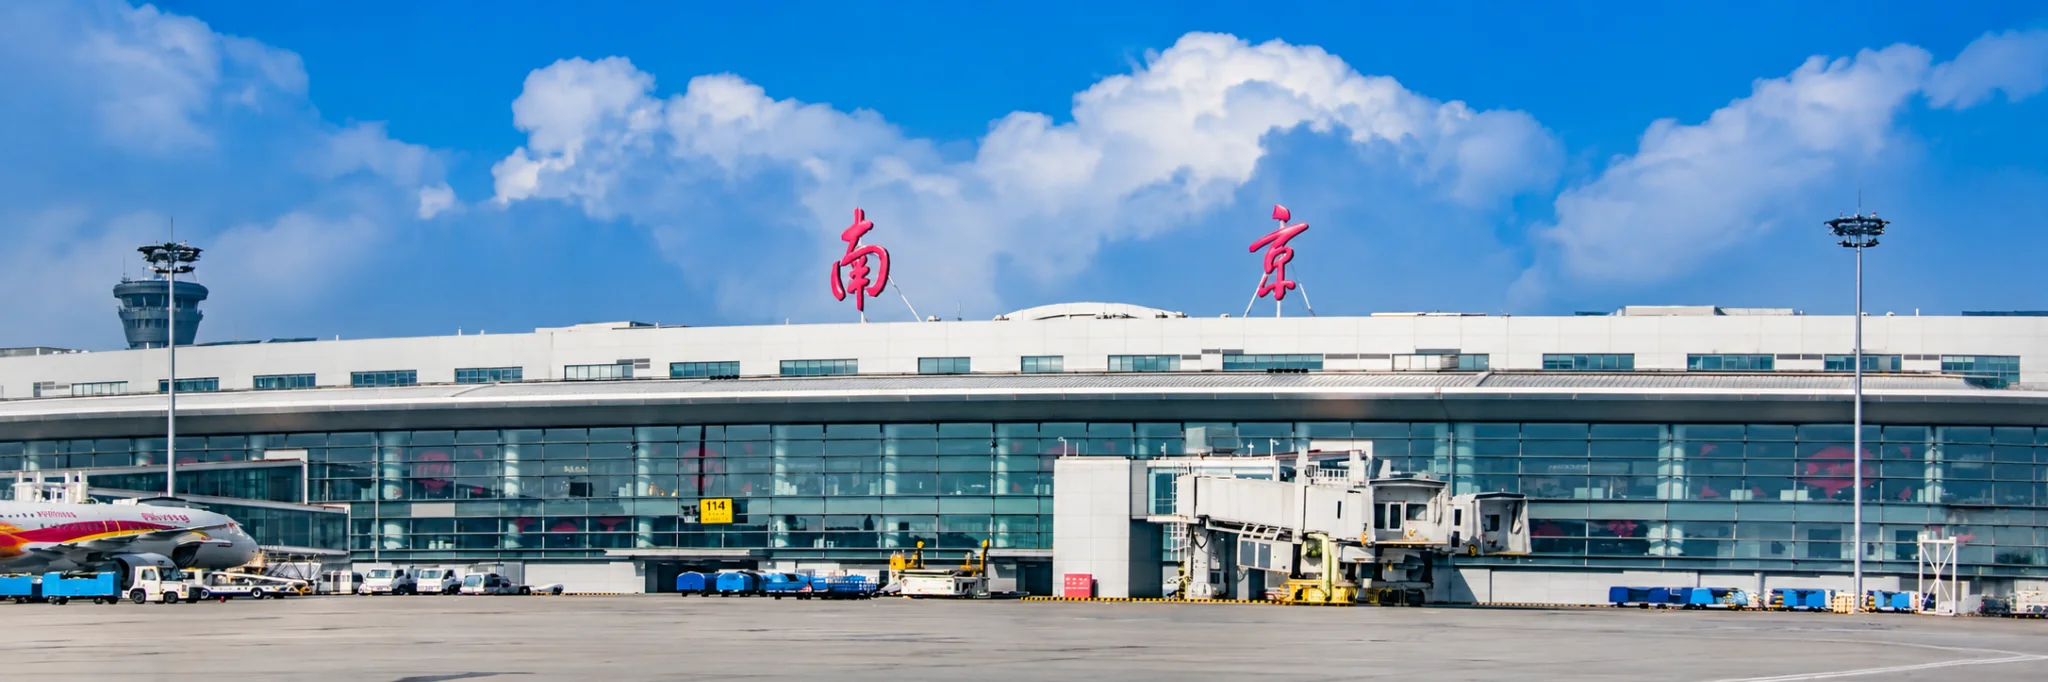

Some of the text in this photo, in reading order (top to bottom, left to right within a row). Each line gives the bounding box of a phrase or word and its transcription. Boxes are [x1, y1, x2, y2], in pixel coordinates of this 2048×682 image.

[831, 205, 1309, 311] 南 京
[706, 501, 725, 511] 114
